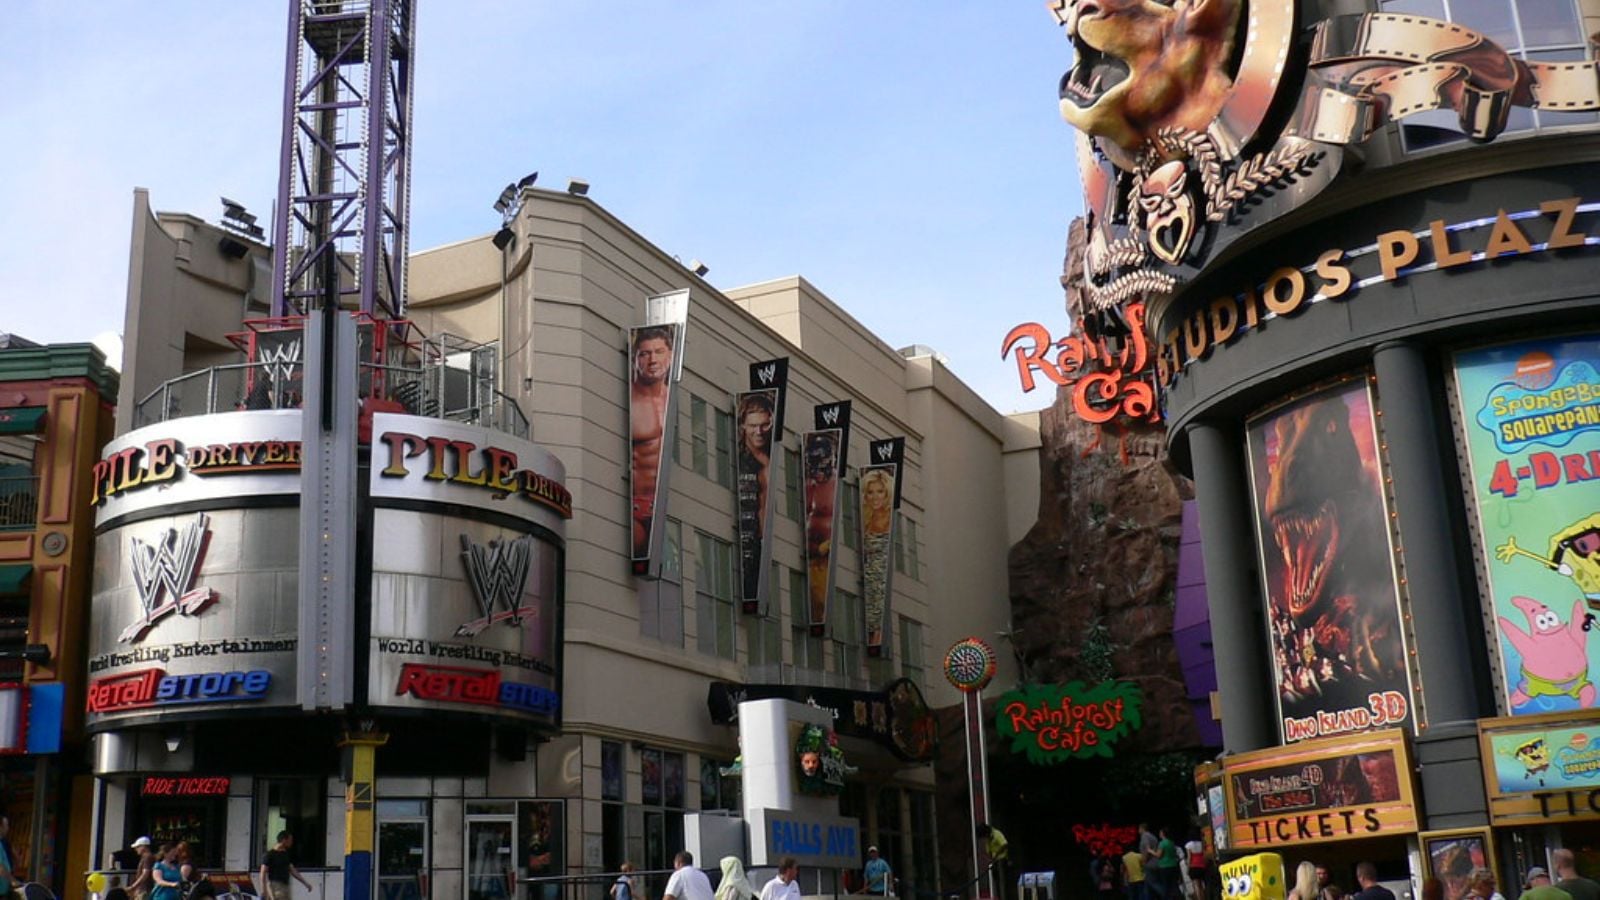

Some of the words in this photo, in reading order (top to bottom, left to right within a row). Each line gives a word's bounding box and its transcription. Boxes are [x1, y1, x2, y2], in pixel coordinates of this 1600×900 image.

[1157, 249, 1351, 388] STUDIOS
[1377, 197, 1586, 281] PLAZ
[1072, 369, 1160, 424] Ca
[91, 438, 178, 505] PILE
[380, 431, 518, 494] PILE
[110, 647, 170, 668] Wrestling
[378, 639, 425, 655] World
[428, 642, 500, 667] Wrestling
[1005, 697, 1123, 732] Rainforest
[1285, 717, 1318, 741] DINO
[1317, 707, 1371, 735] ISLAND
[1368, 691, 1406, 726] 3D
[1037, 721, 1098, 751] Cafe
[143, 778, 176, 795] RIDE
[176, 777, 231, 794] TICKETS
[772, 820, 822, 856] FALLS
[827, 824, 857, 858] AVE
[1250, 808, 1381, 844] TICKETS
